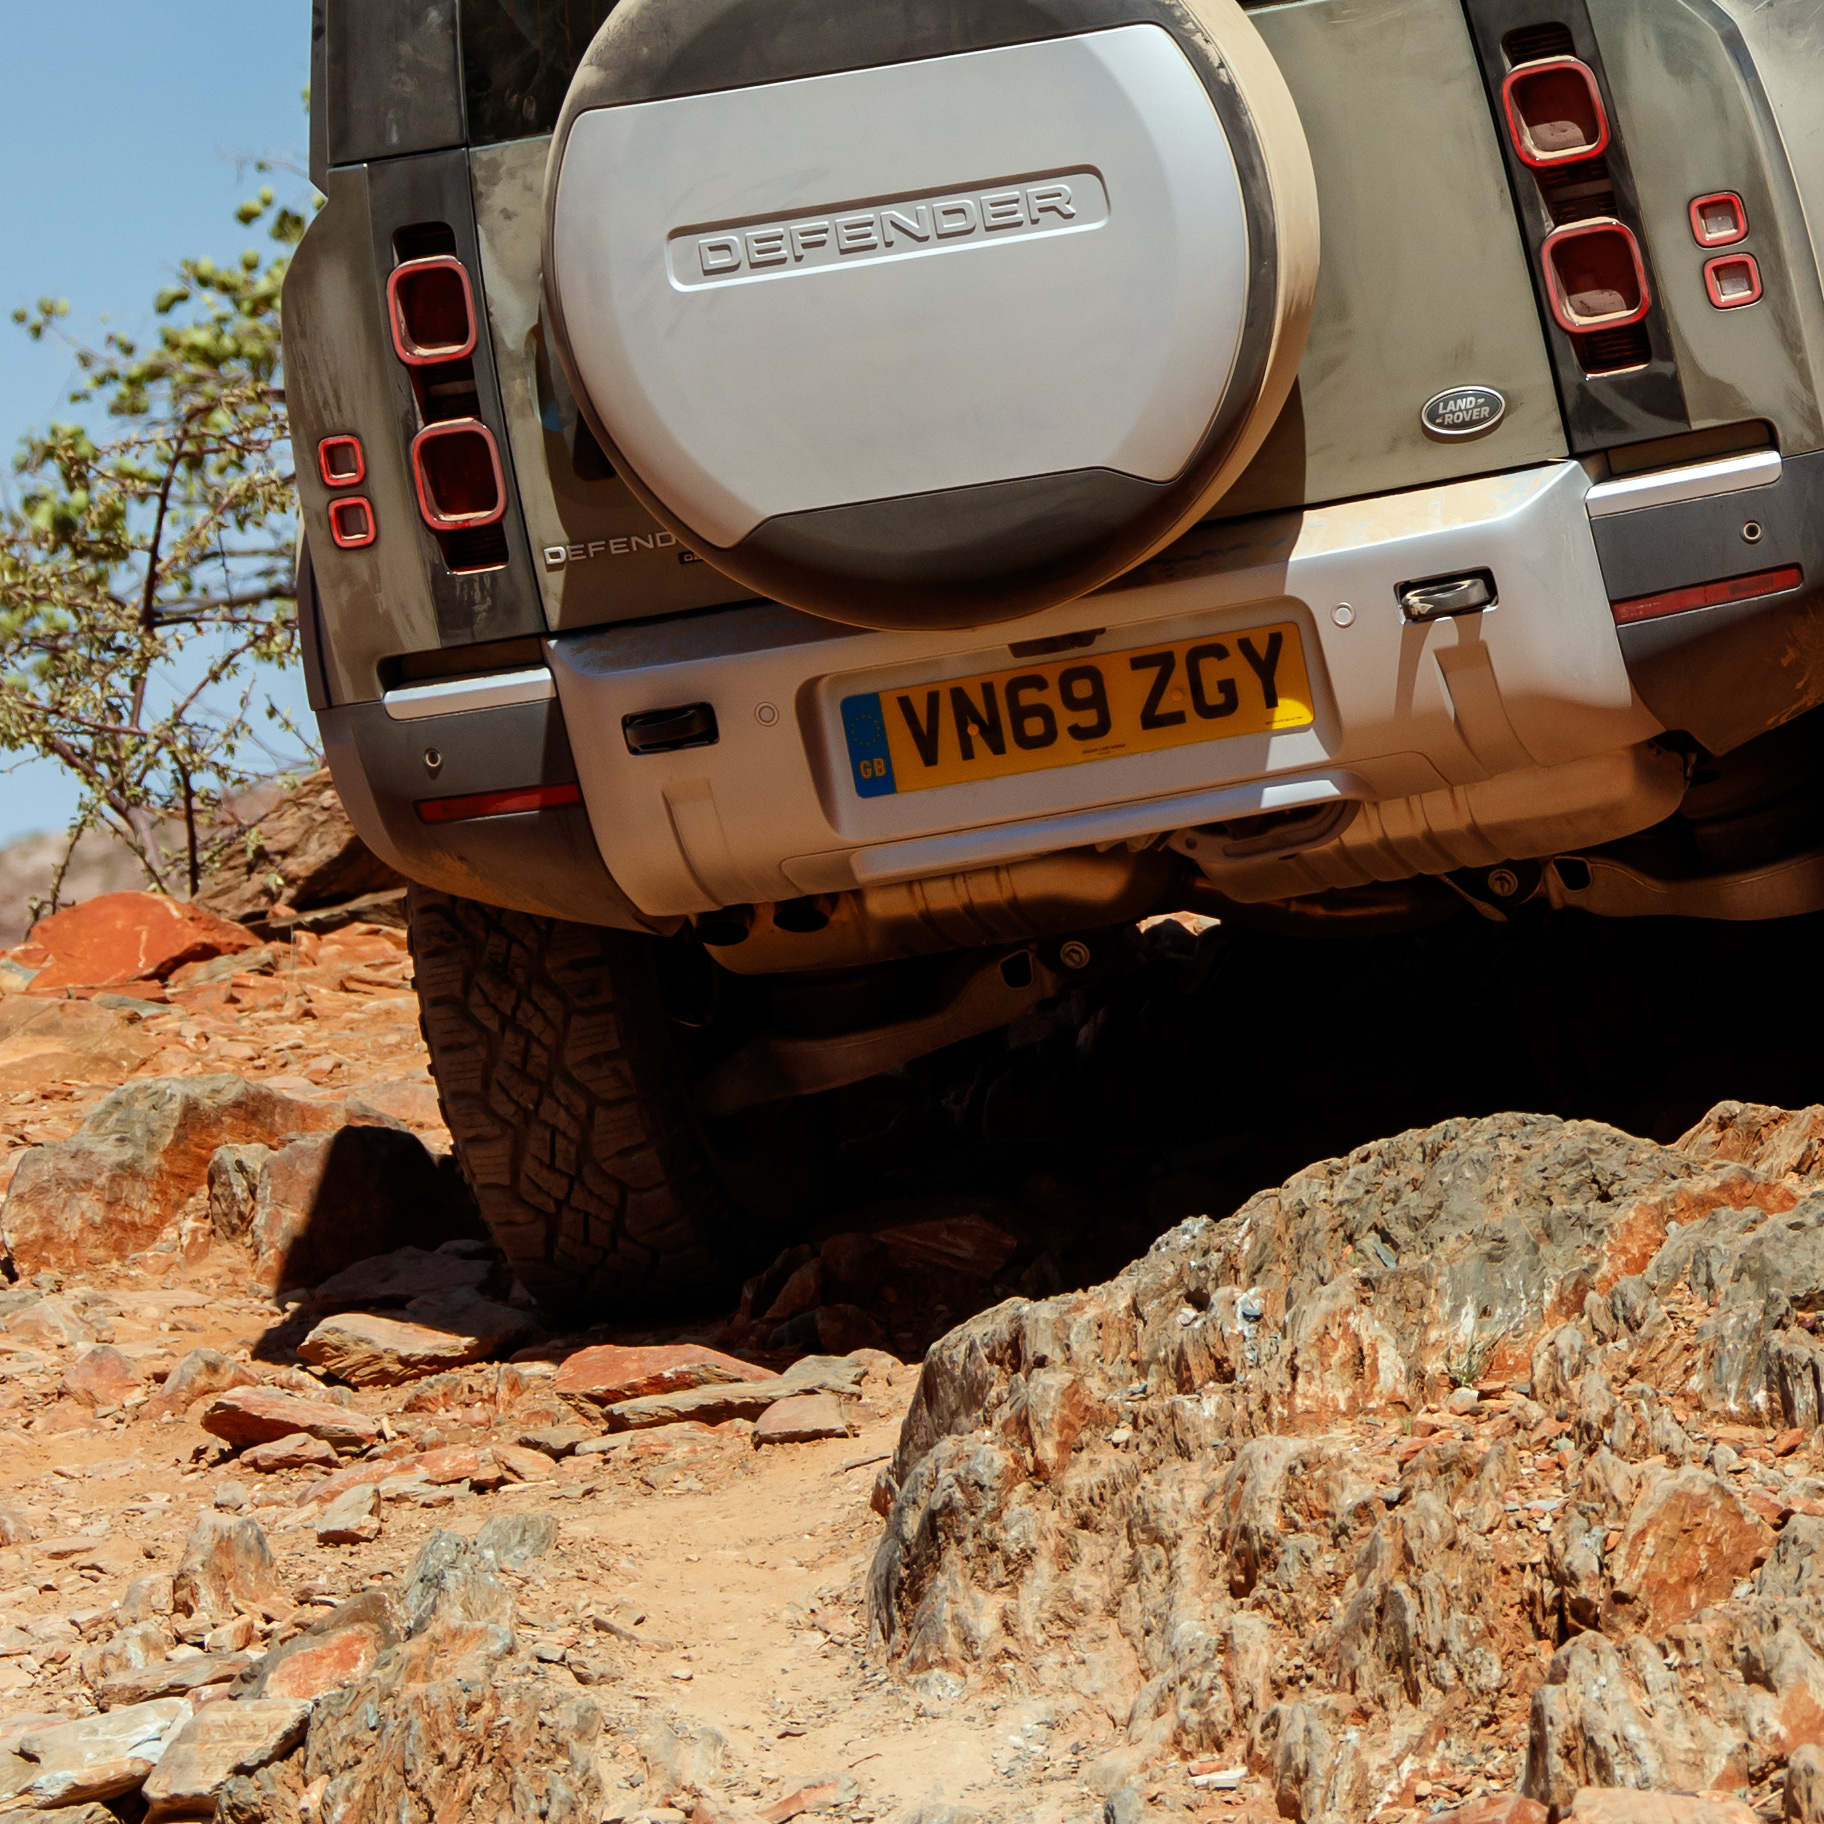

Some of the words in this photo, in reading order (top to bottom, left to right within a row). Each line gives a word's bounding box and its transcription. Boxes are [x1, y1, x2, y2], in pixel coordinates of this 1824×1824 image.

[698, 183, 1077, 277] DEFENDER
[1438, 396, 1476, 414] LAND
[1443, 406, 1490, 425] ROVER
[543, 530, 677, 565] DEFEND
[896, 664, 1113, 768] VN69
[1129, 631, 1284, 732] ZGY
[859, 757, 886, 780] GB
